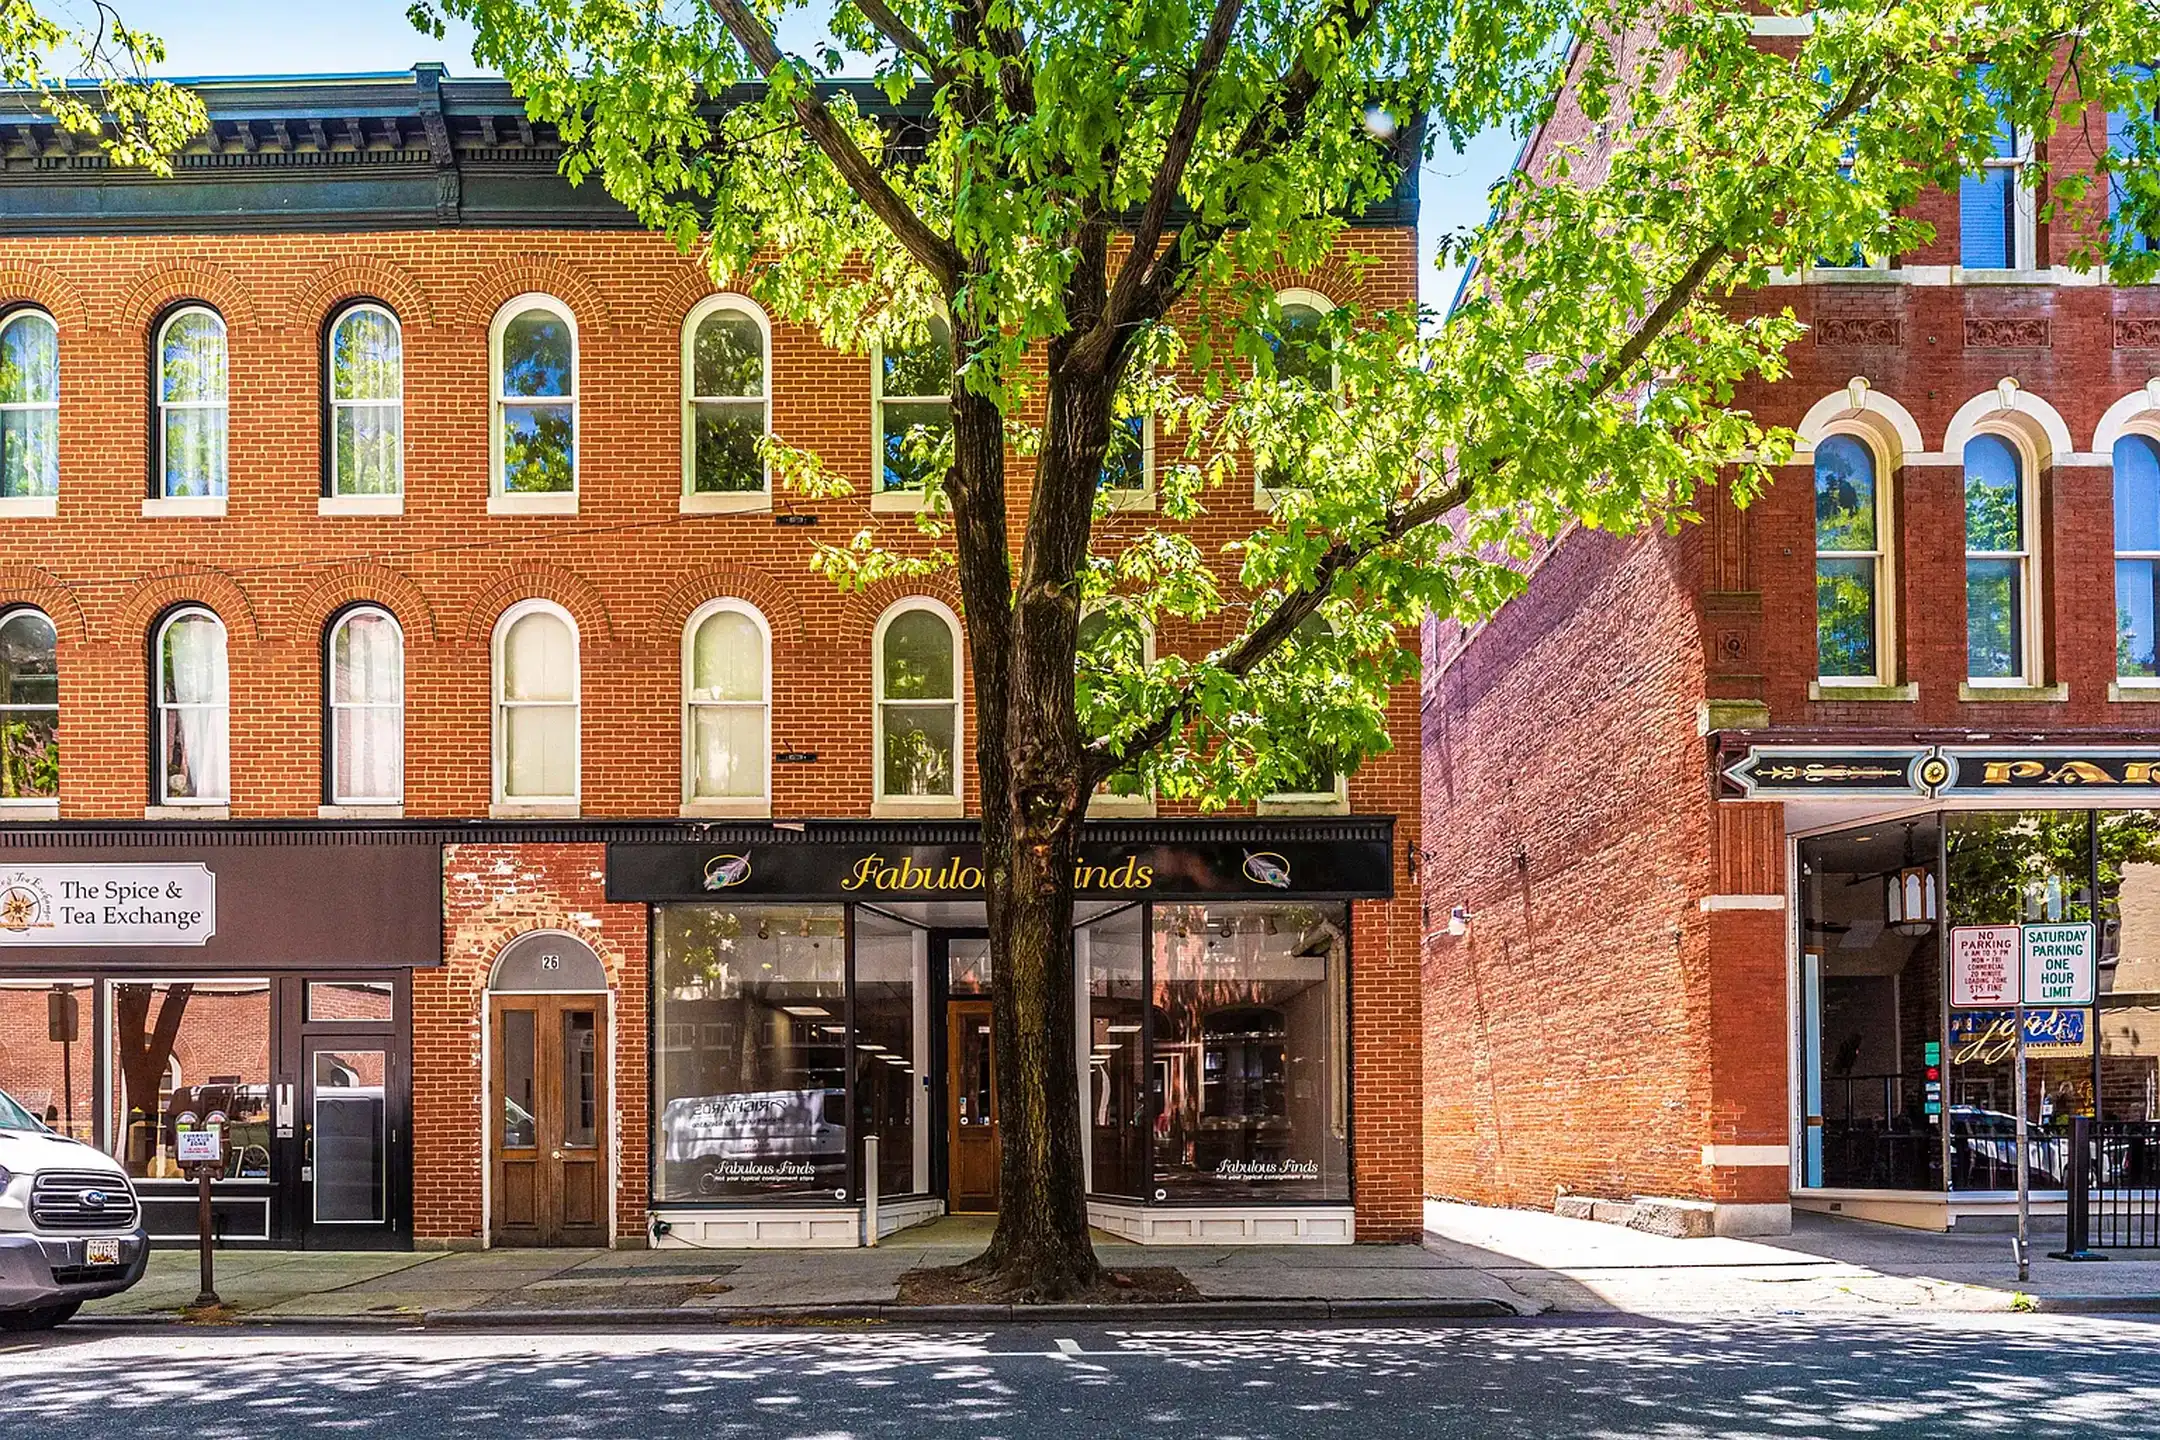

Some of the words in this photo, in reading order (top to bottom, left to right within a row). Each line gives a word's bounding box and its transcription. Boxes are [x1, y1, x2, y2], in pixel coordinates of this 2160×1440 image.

[840, 852, 986, 890] Fabulo
[1073, 856, 1153, 889] inds
[60, 881, 99, 899] The
[105, 881, 159, 905] Spice
[165, 881, 182, 899] &
[60, 906, 96, 924] Tea
[103, 906, 201, 930] Exchange
[1978, 931, 1994, 940] NO
[2028, 930, 2087, 943] SATURDAY
[1961, 940, 2012, 949] PARKING
[2032, 944, 2083, 957] PARKING
[543, 956, 558, 969] 26
[2045, 959, 2070, 970] ONE
[2041, 972, 2074, 984] HOUR
[1987, 984, 2003, 992] FINE
[2042, 986, 2072, 998] LIMIT
[714, 1161, 774, 1175] Fabulous
[776, 1160, 815, 1175] Finds
[1216, 1158, 1277, 1173] Fabulous
[1279, 1158, 1319, 1173] Finds
